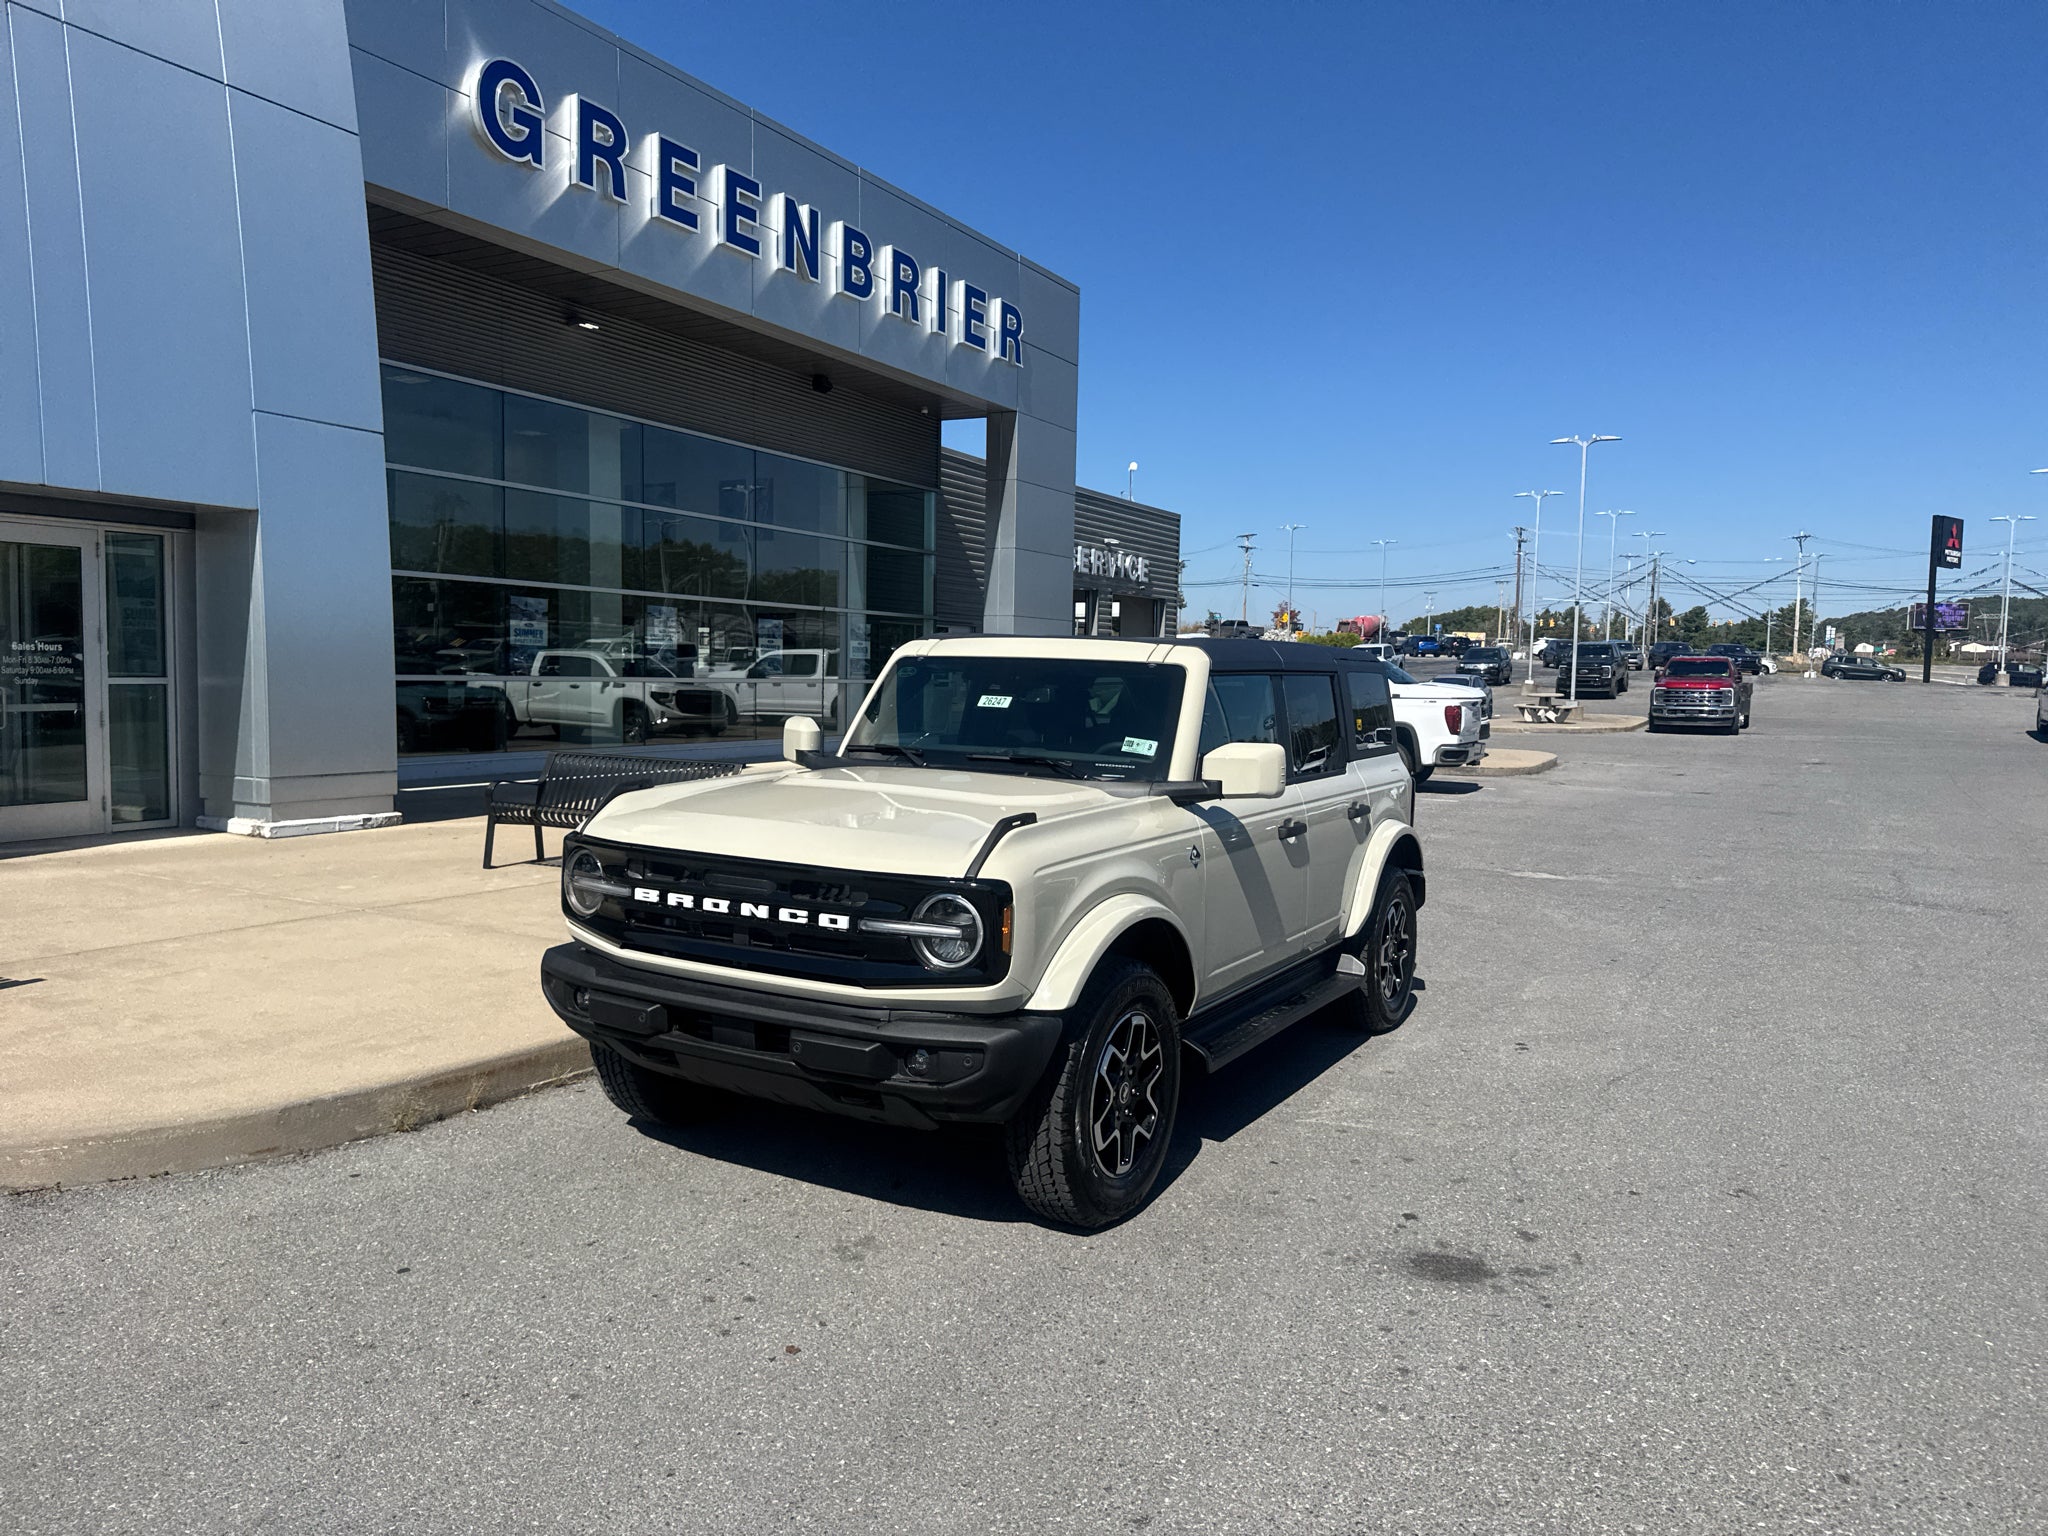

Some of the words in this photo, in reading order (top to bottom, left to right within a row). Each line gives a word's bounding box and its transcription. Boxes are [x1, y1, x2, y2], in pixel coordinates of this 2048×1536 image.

[470, 56, 1024, 368] GREENBRIER
[11, 641, 36, 651] Sales
[37, 641, 63, 652] Hours
[2, 655, 27, 664] Mon-Fri
[1, 665, 29, 676] Saturday
[14, 676, 39, 687] Sunday
[982, 696, 1008, 706] 26247
[633, 886, 850, 930] BRONCO
